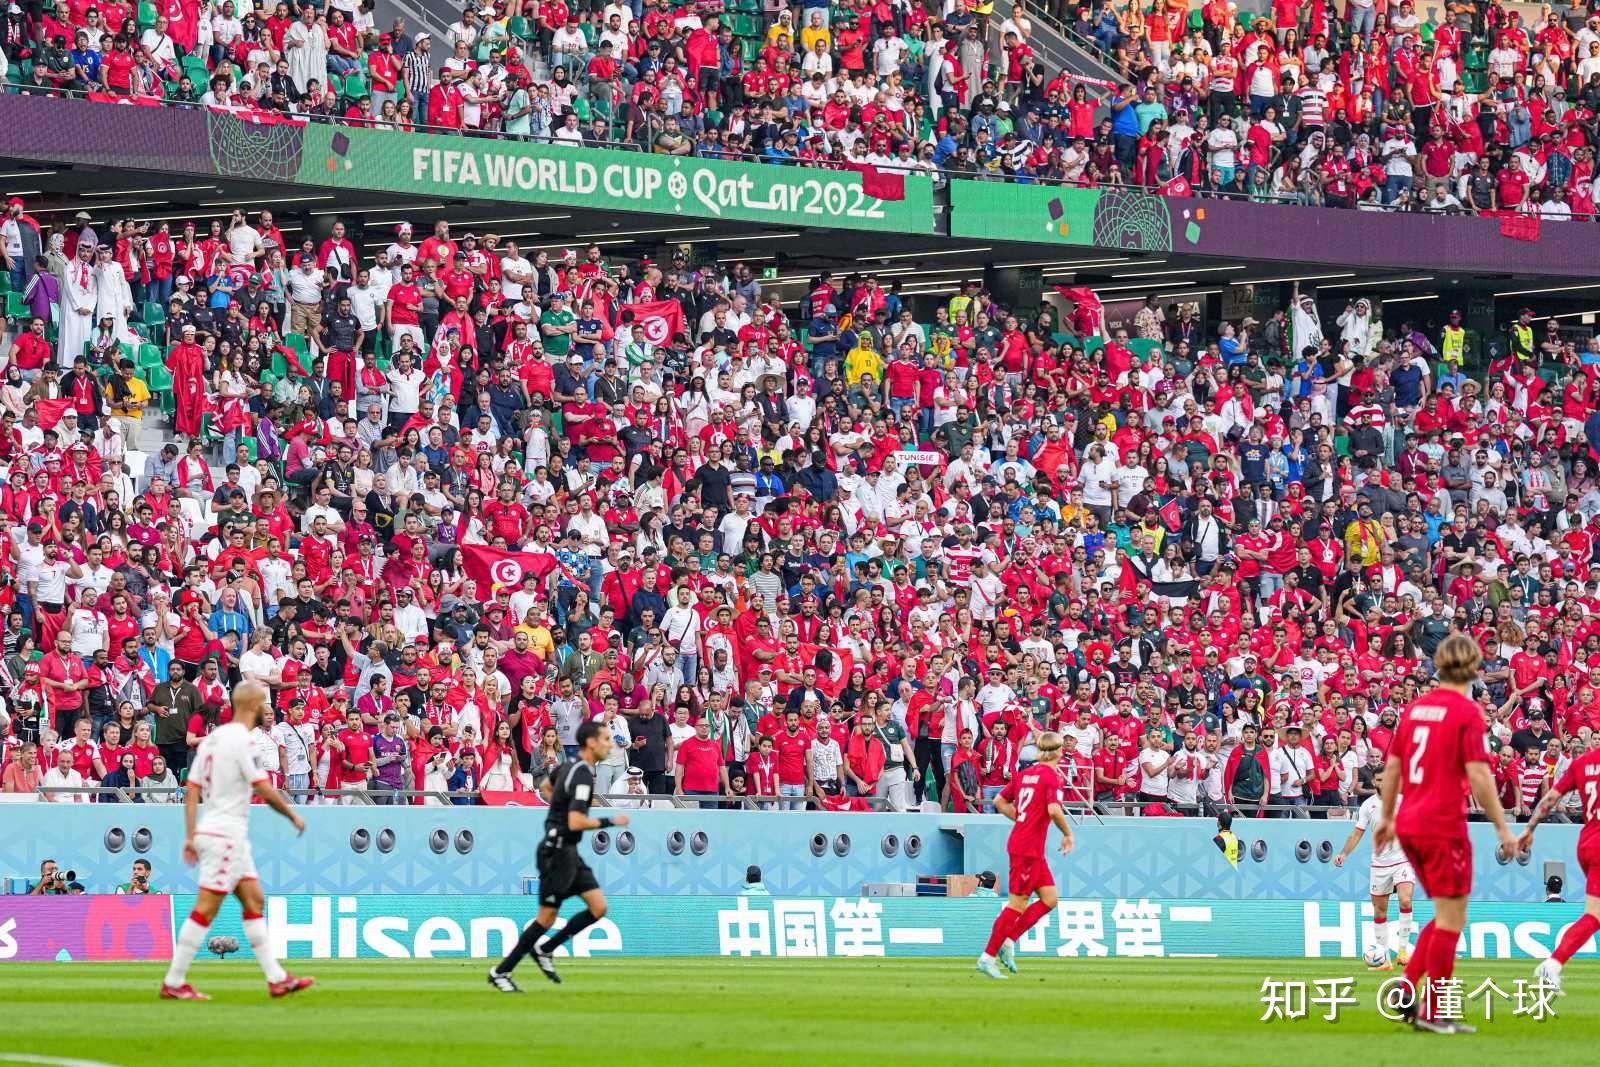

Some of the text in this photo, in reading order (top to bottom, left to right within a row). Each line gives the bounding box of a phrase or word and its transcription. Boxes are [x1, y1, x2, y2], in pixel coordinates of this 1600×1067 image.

[413, 148, 481, 185] FIFA
[484, 153, 597, 194] WORLD
[603, 164, 662, 199] CUP
[900, 454, 934, 462] TUNISIE
[1409, 726, 1431, 785] 2
[1016, 787, 1035, 822] 12
[717, 897, 943, 957] 中国第一
